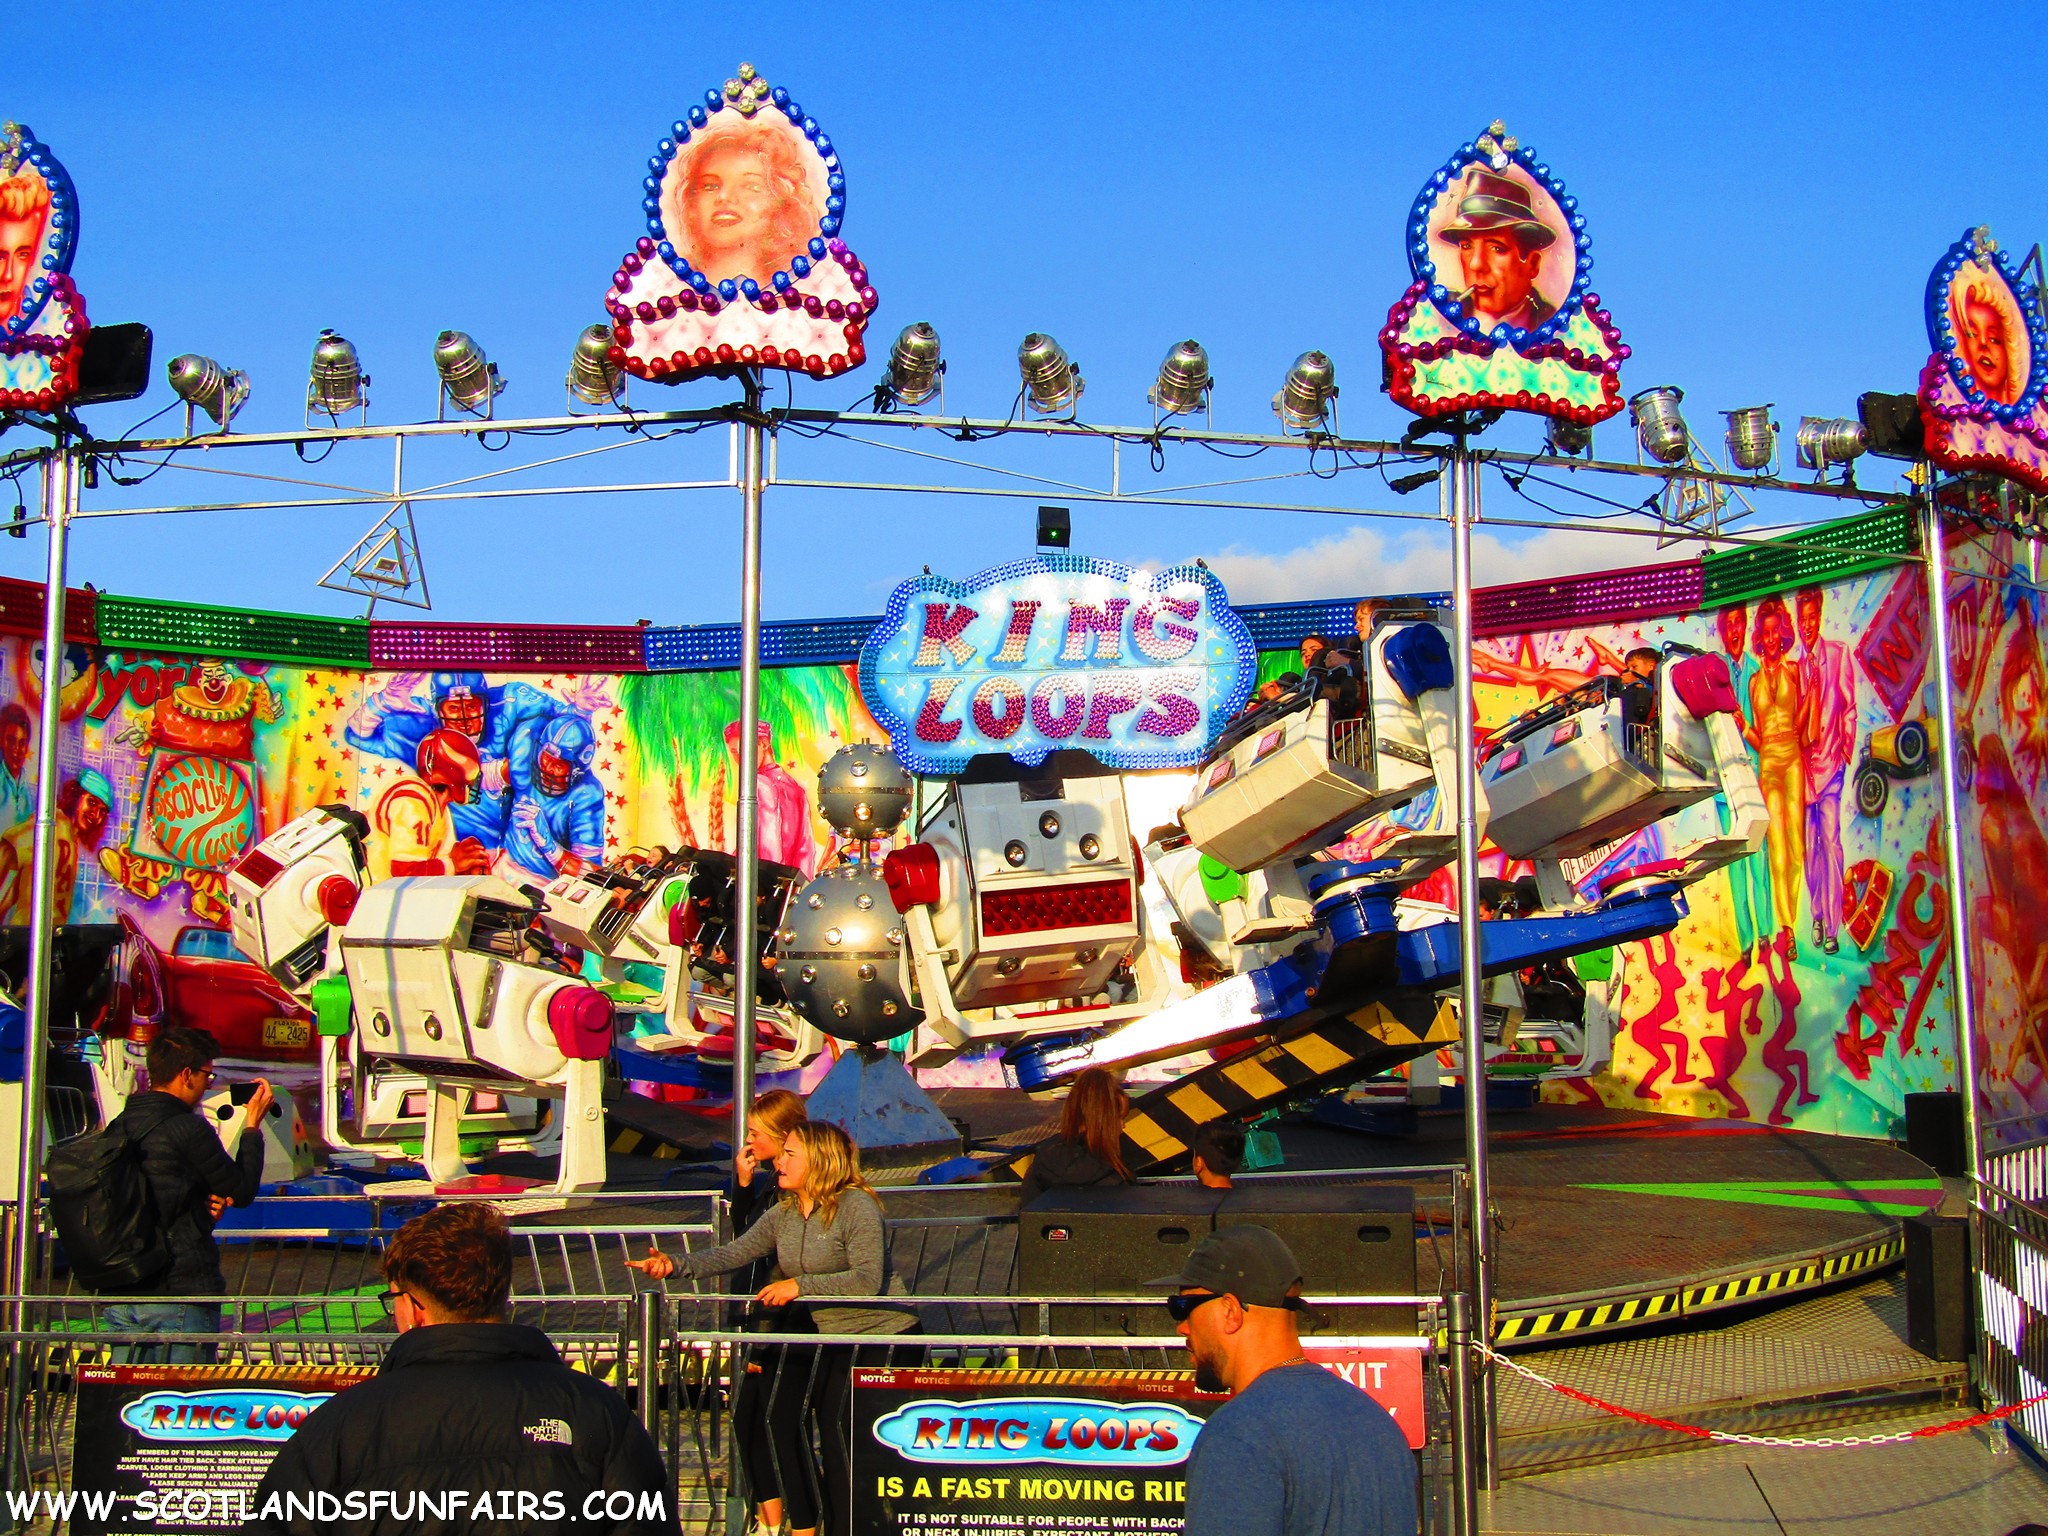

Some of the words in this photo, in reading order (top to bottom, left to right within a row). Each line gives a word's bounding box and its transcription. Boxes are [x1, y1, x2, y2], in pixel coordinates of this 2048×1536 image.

[913, 596, 1201, 667] KING
[915, 671, 1201, 743] LOOPS
[84, 1370, 116, 1379] NOTICE
[132, 1372, 166, 1381] NOTICE
[860, 1374, 896, 1384] NOTICE
[914, 1376, 950, 1385] NOTICE
[1137, 1384, 1174, 1393] NOTICE
[148, 1404, 237, 1430] KING
[245, 1403, 319, 1430] LOO
[539, 1418, 559, 1427] THE
[523, 1426, 558, 1434] NORTH
[911, 1417, 1029, 1450] KING
[1042, 1417, 1179, 1451] LOOPS
[533, 1433, 559, 1442] FACE
[877, 1476, 904, 1498] IS
[912, 1477, 933, 1498] A
[941, 1477, 1011, 1499] FAST
[1020, 1479, 1135, 1501] MOVING
[1144, 1480, 1186, 1502] RID
[897, 1513, 911, 1524] IT
[914, 1513, 927, 1524] IS
[930, 1514, 957, 1525] NOT
[960, 1514, 1025, 1526] SUITABLE
[1028, 1515, 1054, 1526] FOR
[1058, 1516, 1109, 1527] PEOPLE
[1112, 1517, 1147, 1528] WITH
[1150, 1517, 1185, 1528] BACK
[902, 1527, 921, 1536] OR
[924, 1528, 961, 1536] NECK
